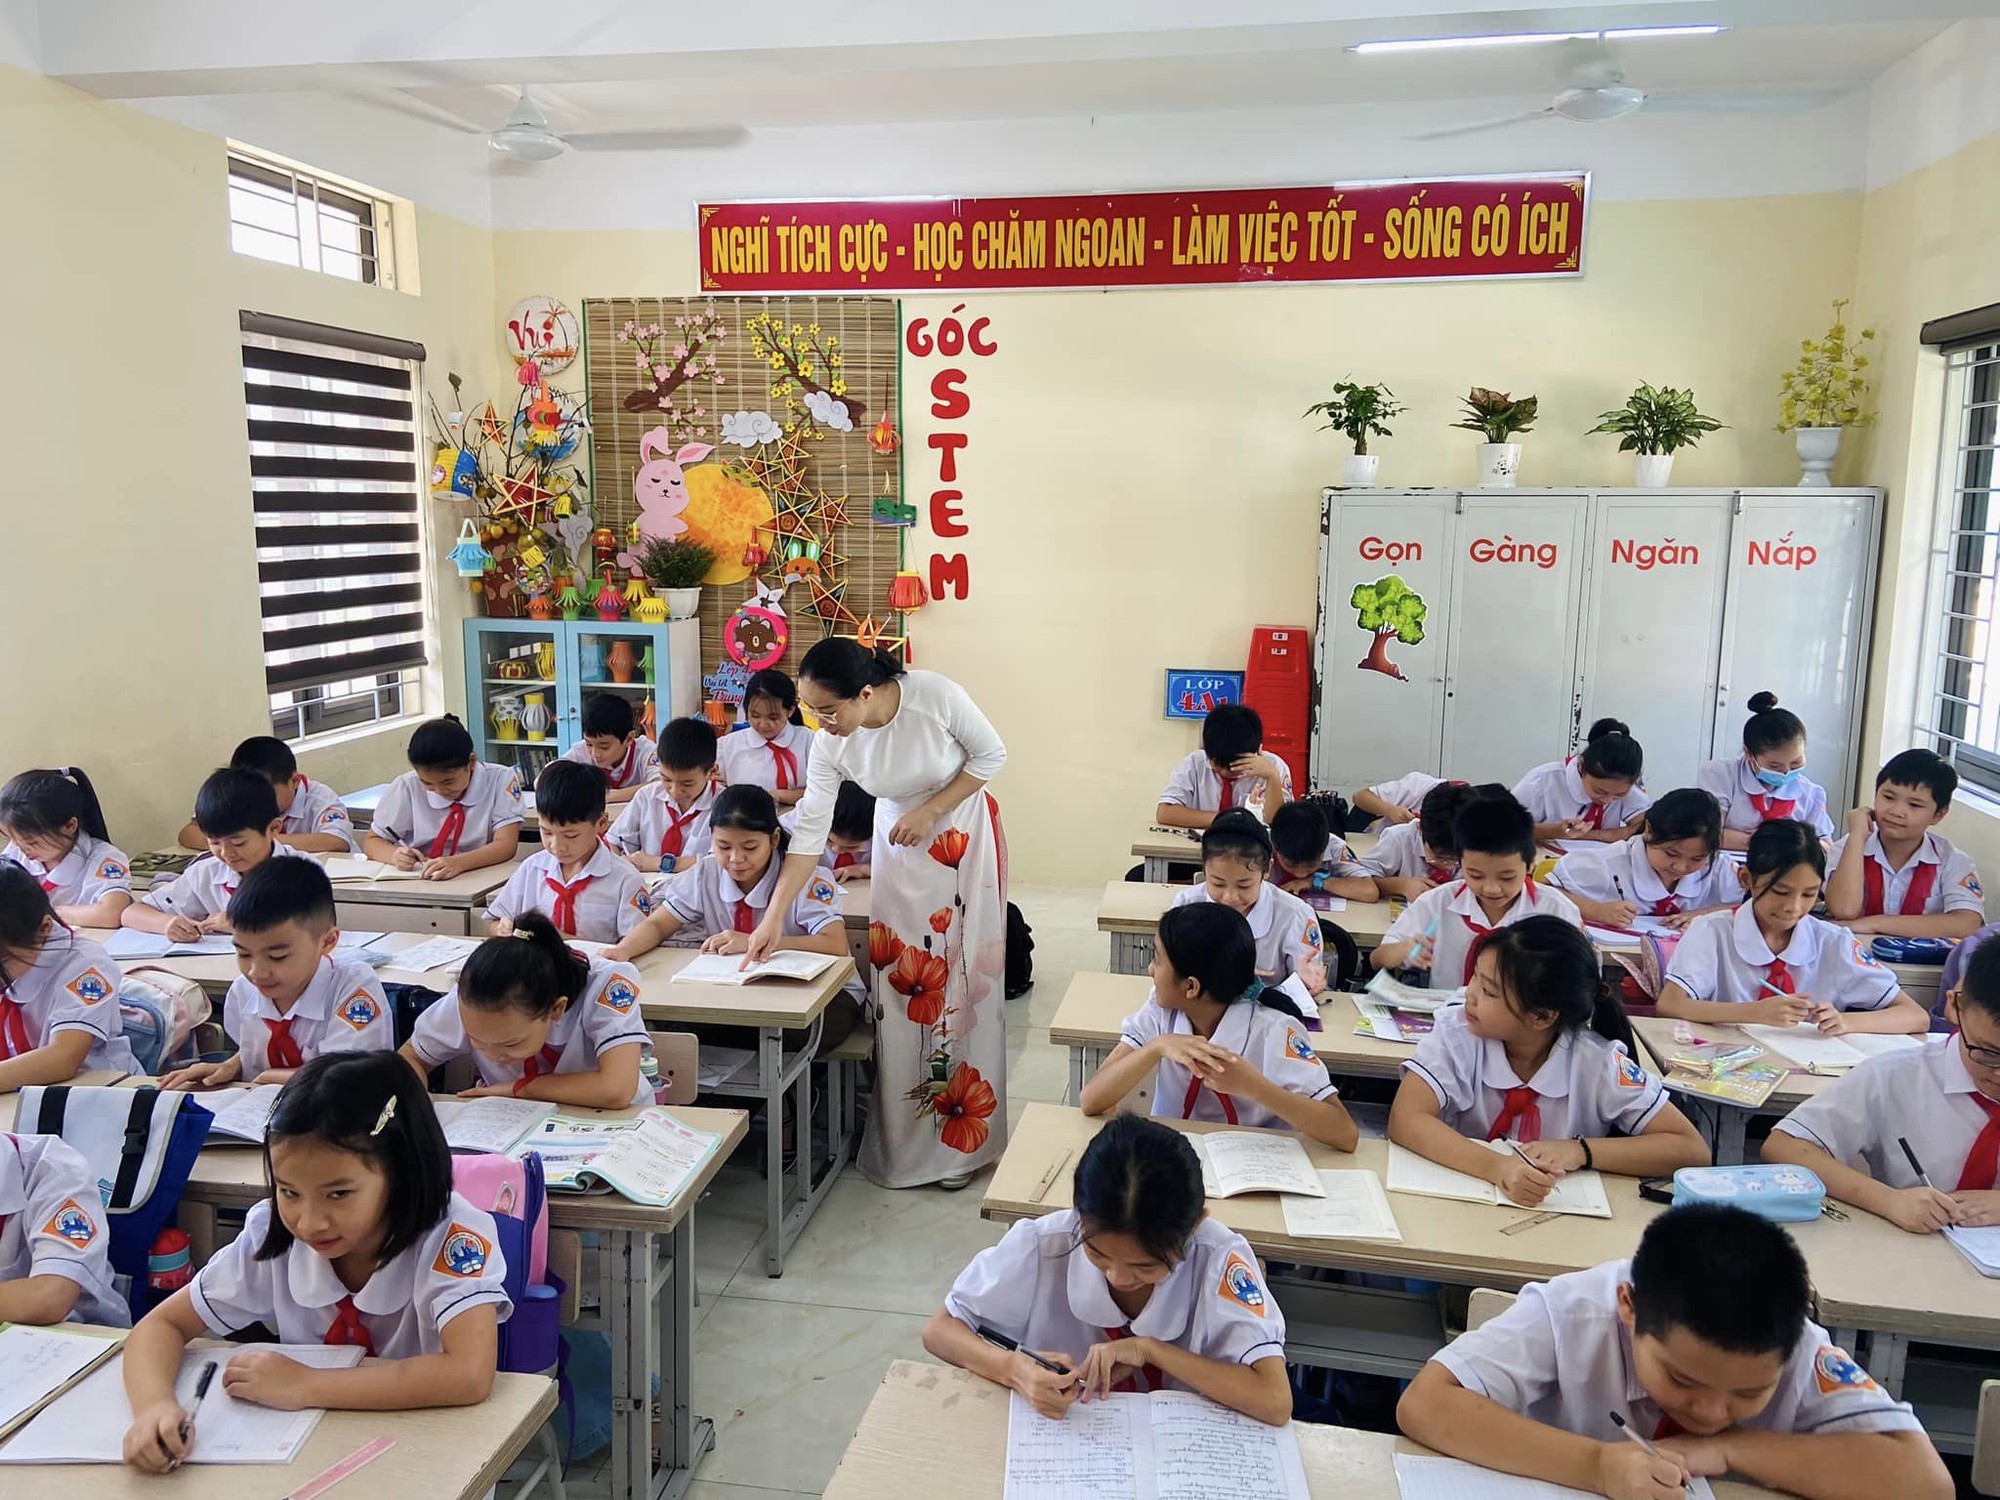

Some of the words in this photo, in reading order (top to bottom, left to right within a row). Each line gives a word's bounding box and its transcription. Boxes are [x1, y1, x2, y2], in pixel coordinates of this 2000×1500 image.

[711, 216, 770, 274] NGHĨ
[776, 216, 831, 273] TÍCH
[838, 218, 888, 283] CỰC
[913, 221, 963, 282] HỌC
[971, 208, 1046, 270] CHĂM
[1055, 217, 1146, 268] NGOAN
[1172, 203, 1230, 265] LÀM
[1238, 200, 1298, 275] VIỆC
[1307, 194, 1358, 262] TỐT
[1383, 189, 1463, 260] SỐNG
[1471, 193, 1511, 257] CÓ
[1518, 191, 1570, 255] ÍCH
[906, 303, 998, 357] GÓC
[927, 368, 971, 601] STEM
[1358, 536, 1423, 567] Gọn
[1469, 535, 1558, 569] Gàng
[1610, 537, 1700, 571] Ngăn
[1747, 530, 1817, 571] Nắp
[1186, 677, 1224, 690] LỚP
